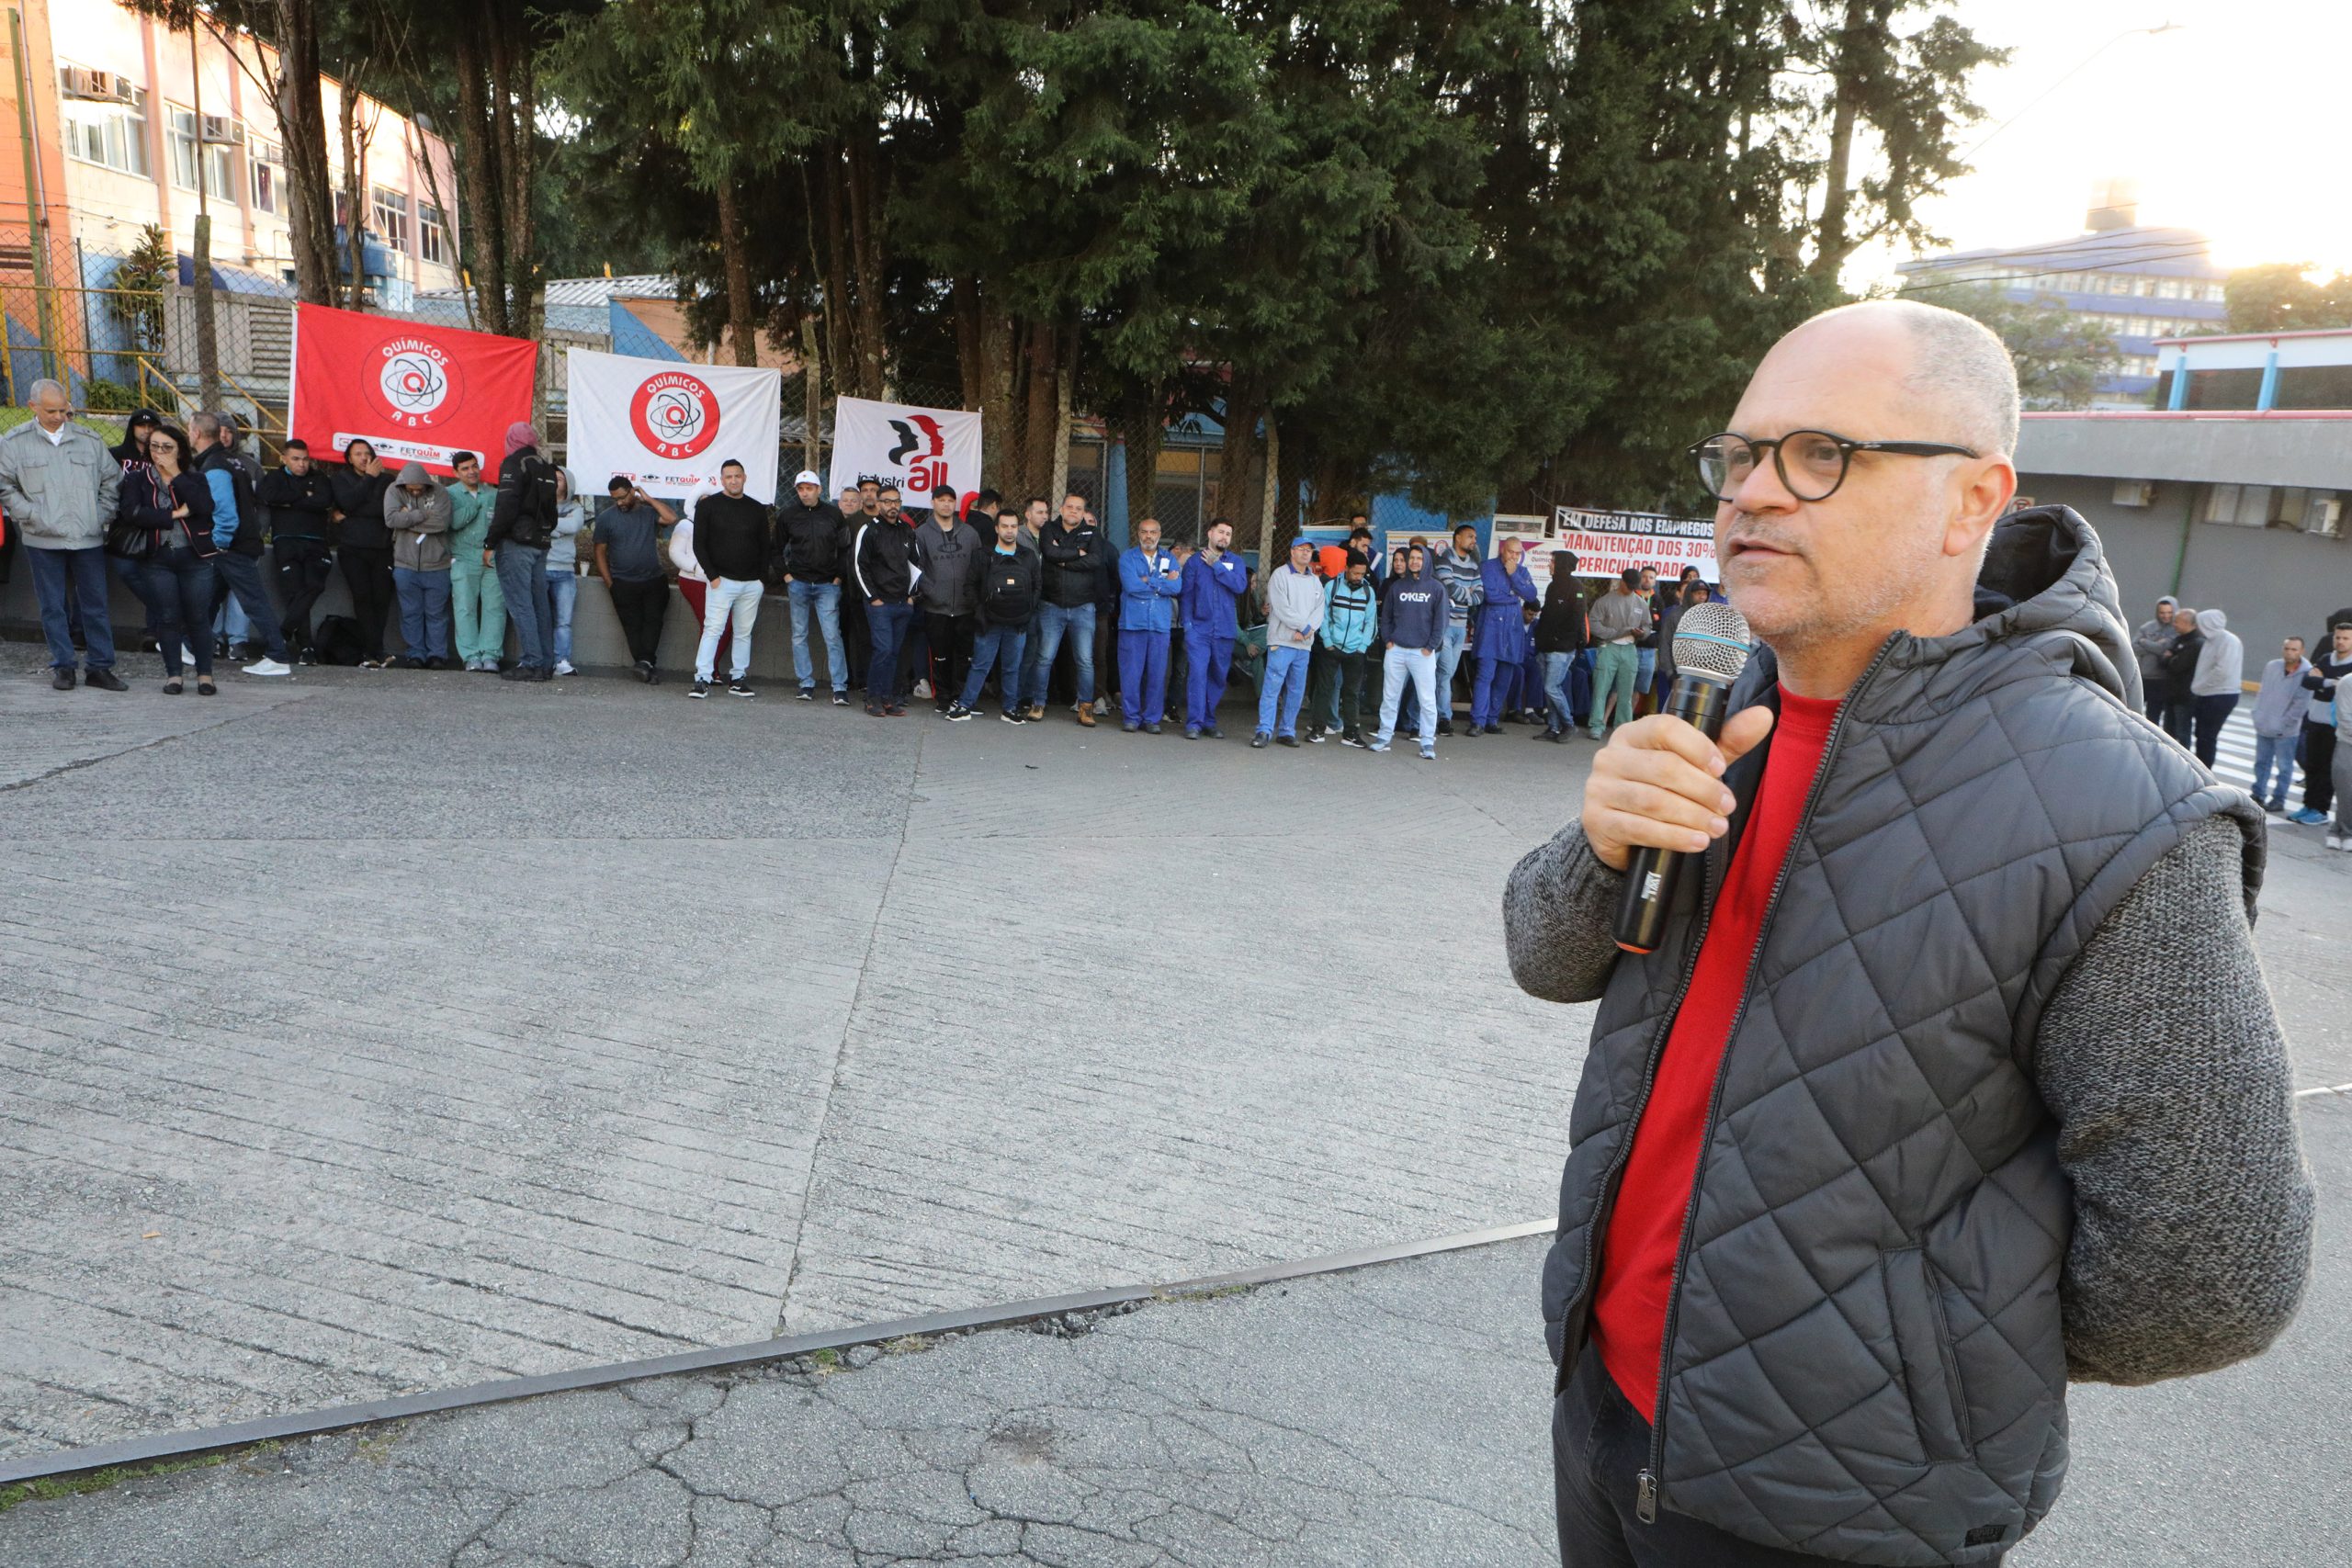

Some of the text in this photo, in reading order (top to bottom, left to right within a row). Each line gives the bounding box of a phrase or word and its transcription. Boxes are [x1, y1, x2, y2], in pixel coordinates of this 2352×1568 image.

[382, 337, 448, 366] QUÍMICOS
[647, 374, 705, 398] QUÍMICOS
[1563, 512, 1714, 536] EM DEFESA DOS EMPREGOS
[1563, 533, 1715, 558] MANUTENÇÃO DOS 30%
[1577, 557, 1686, 577] PERICUODADE
